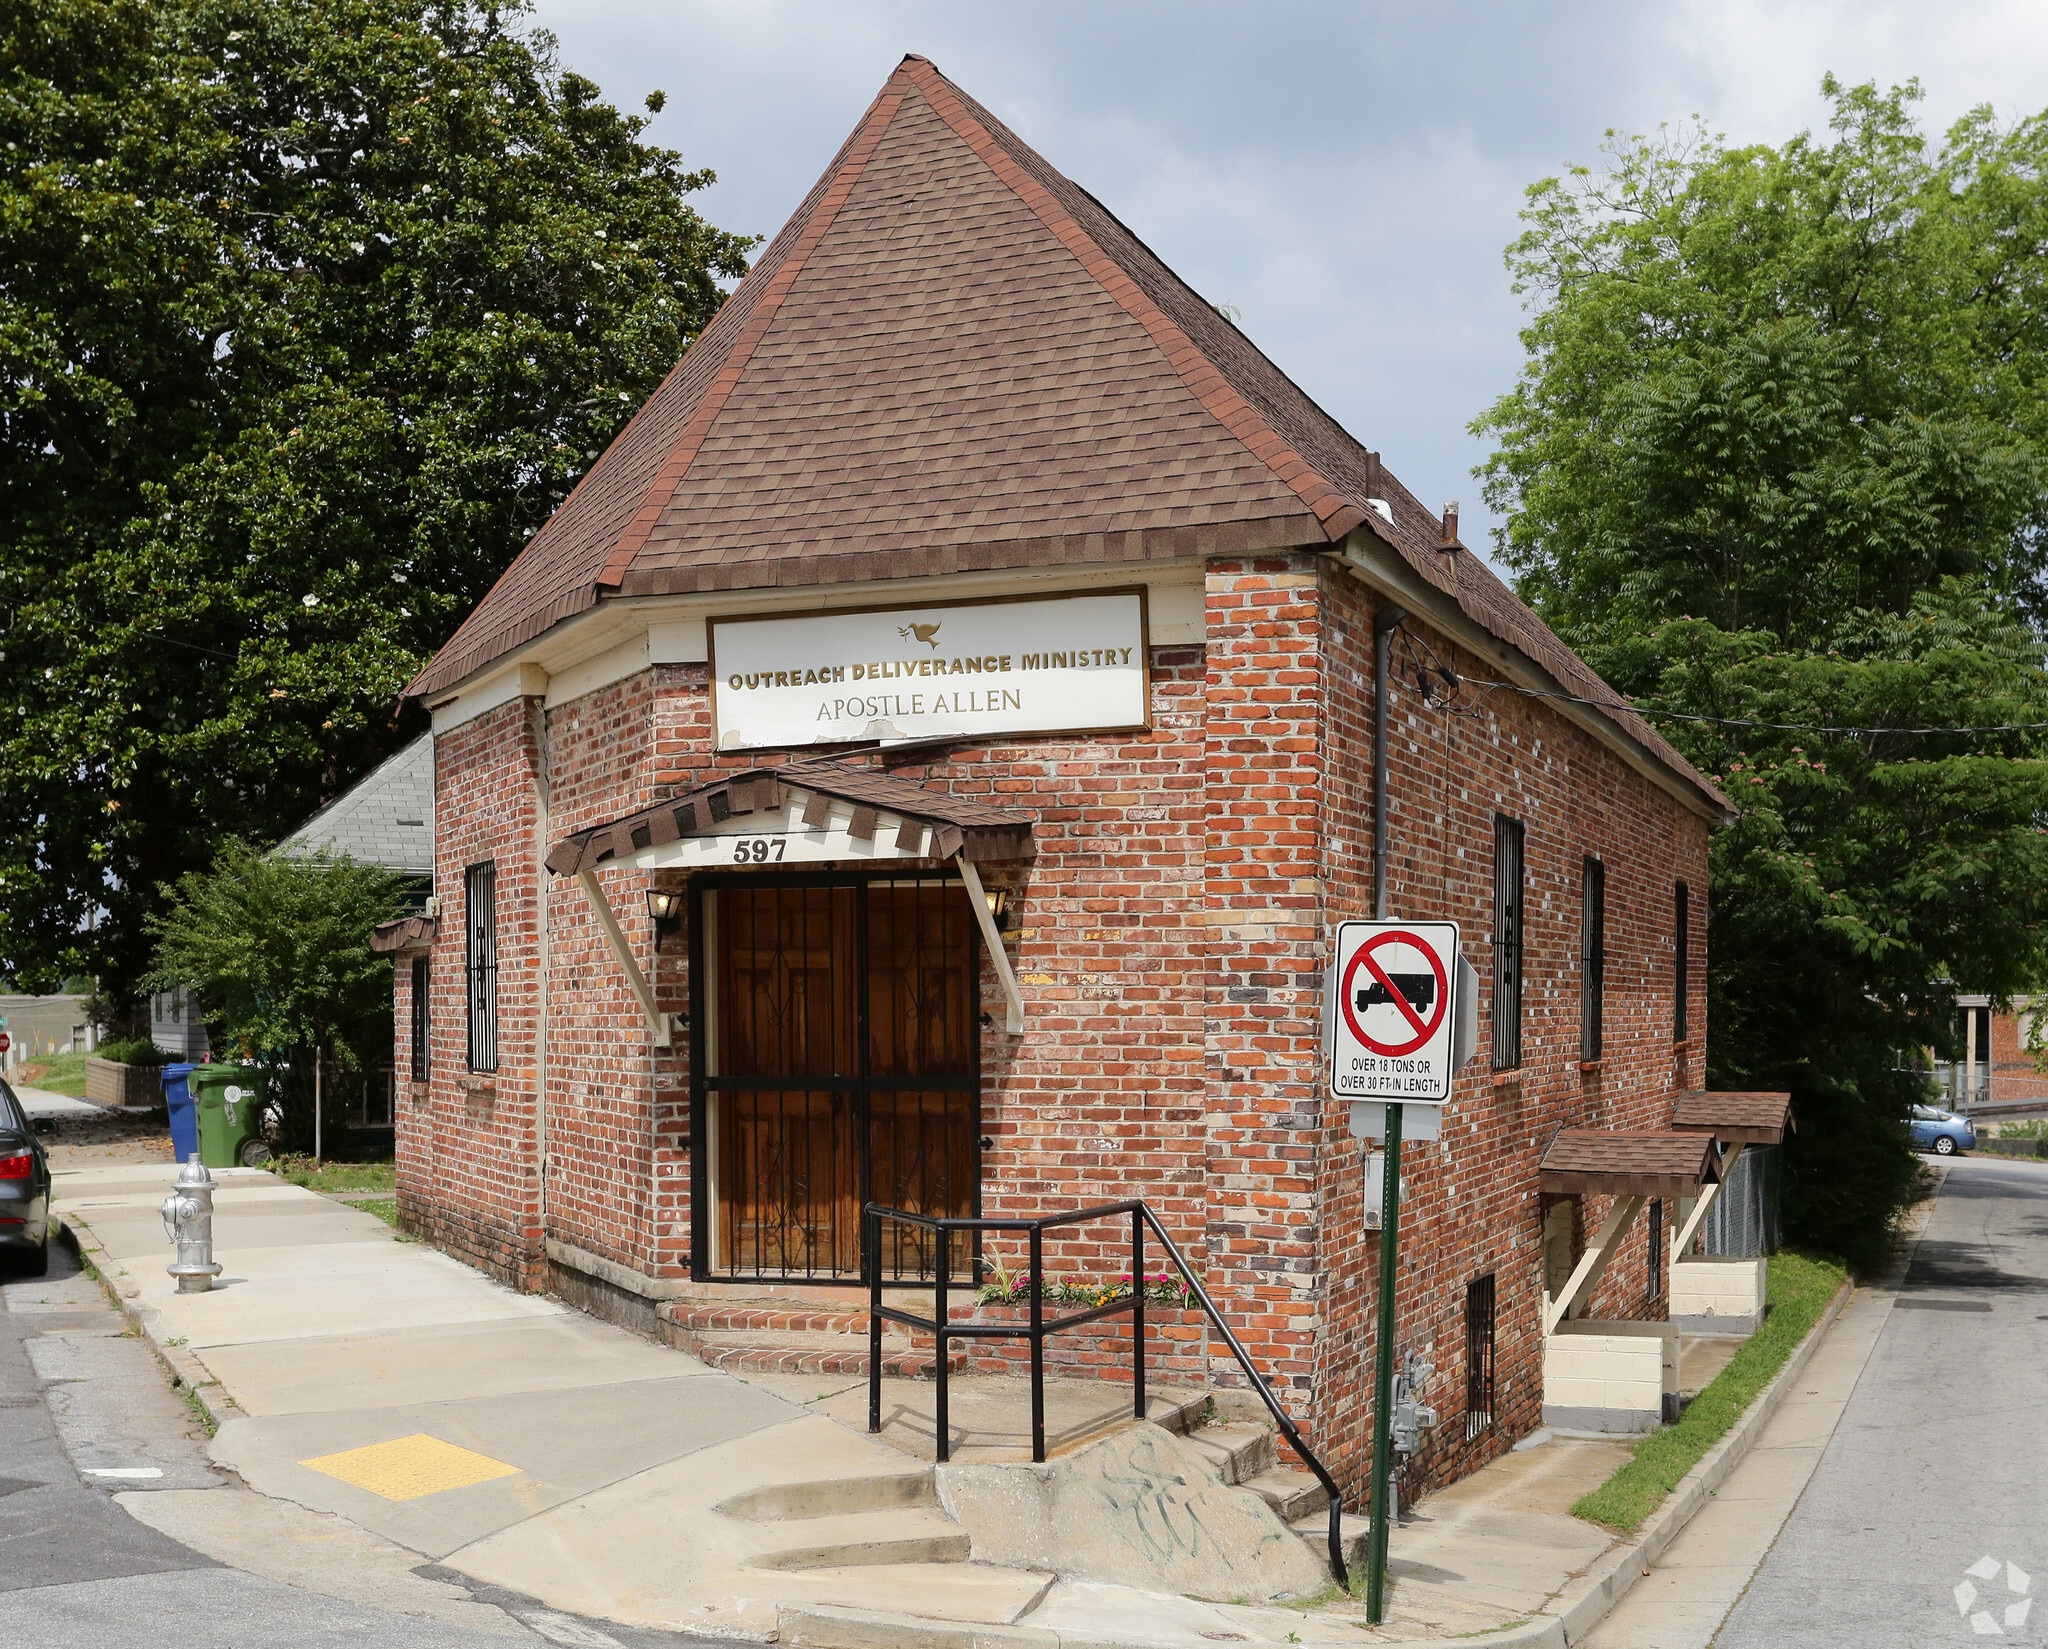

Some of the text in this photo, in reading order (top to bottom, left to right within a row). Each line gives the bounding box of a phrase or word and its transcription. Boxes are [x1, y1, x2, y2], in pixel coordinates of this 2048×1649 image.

[728, 646, 1134, 691] OUTREACH DELIVERANCE MINISTRY
[816, 688, 1021, 721] APOSTLE ALLEN
[733, 838, 787, 864] 597
[1351, 1057, 1431, 1074] OVER 18 TONS OR
[1340, 1075, 1441, 1093] OVER 30 FT IN LENGTH
